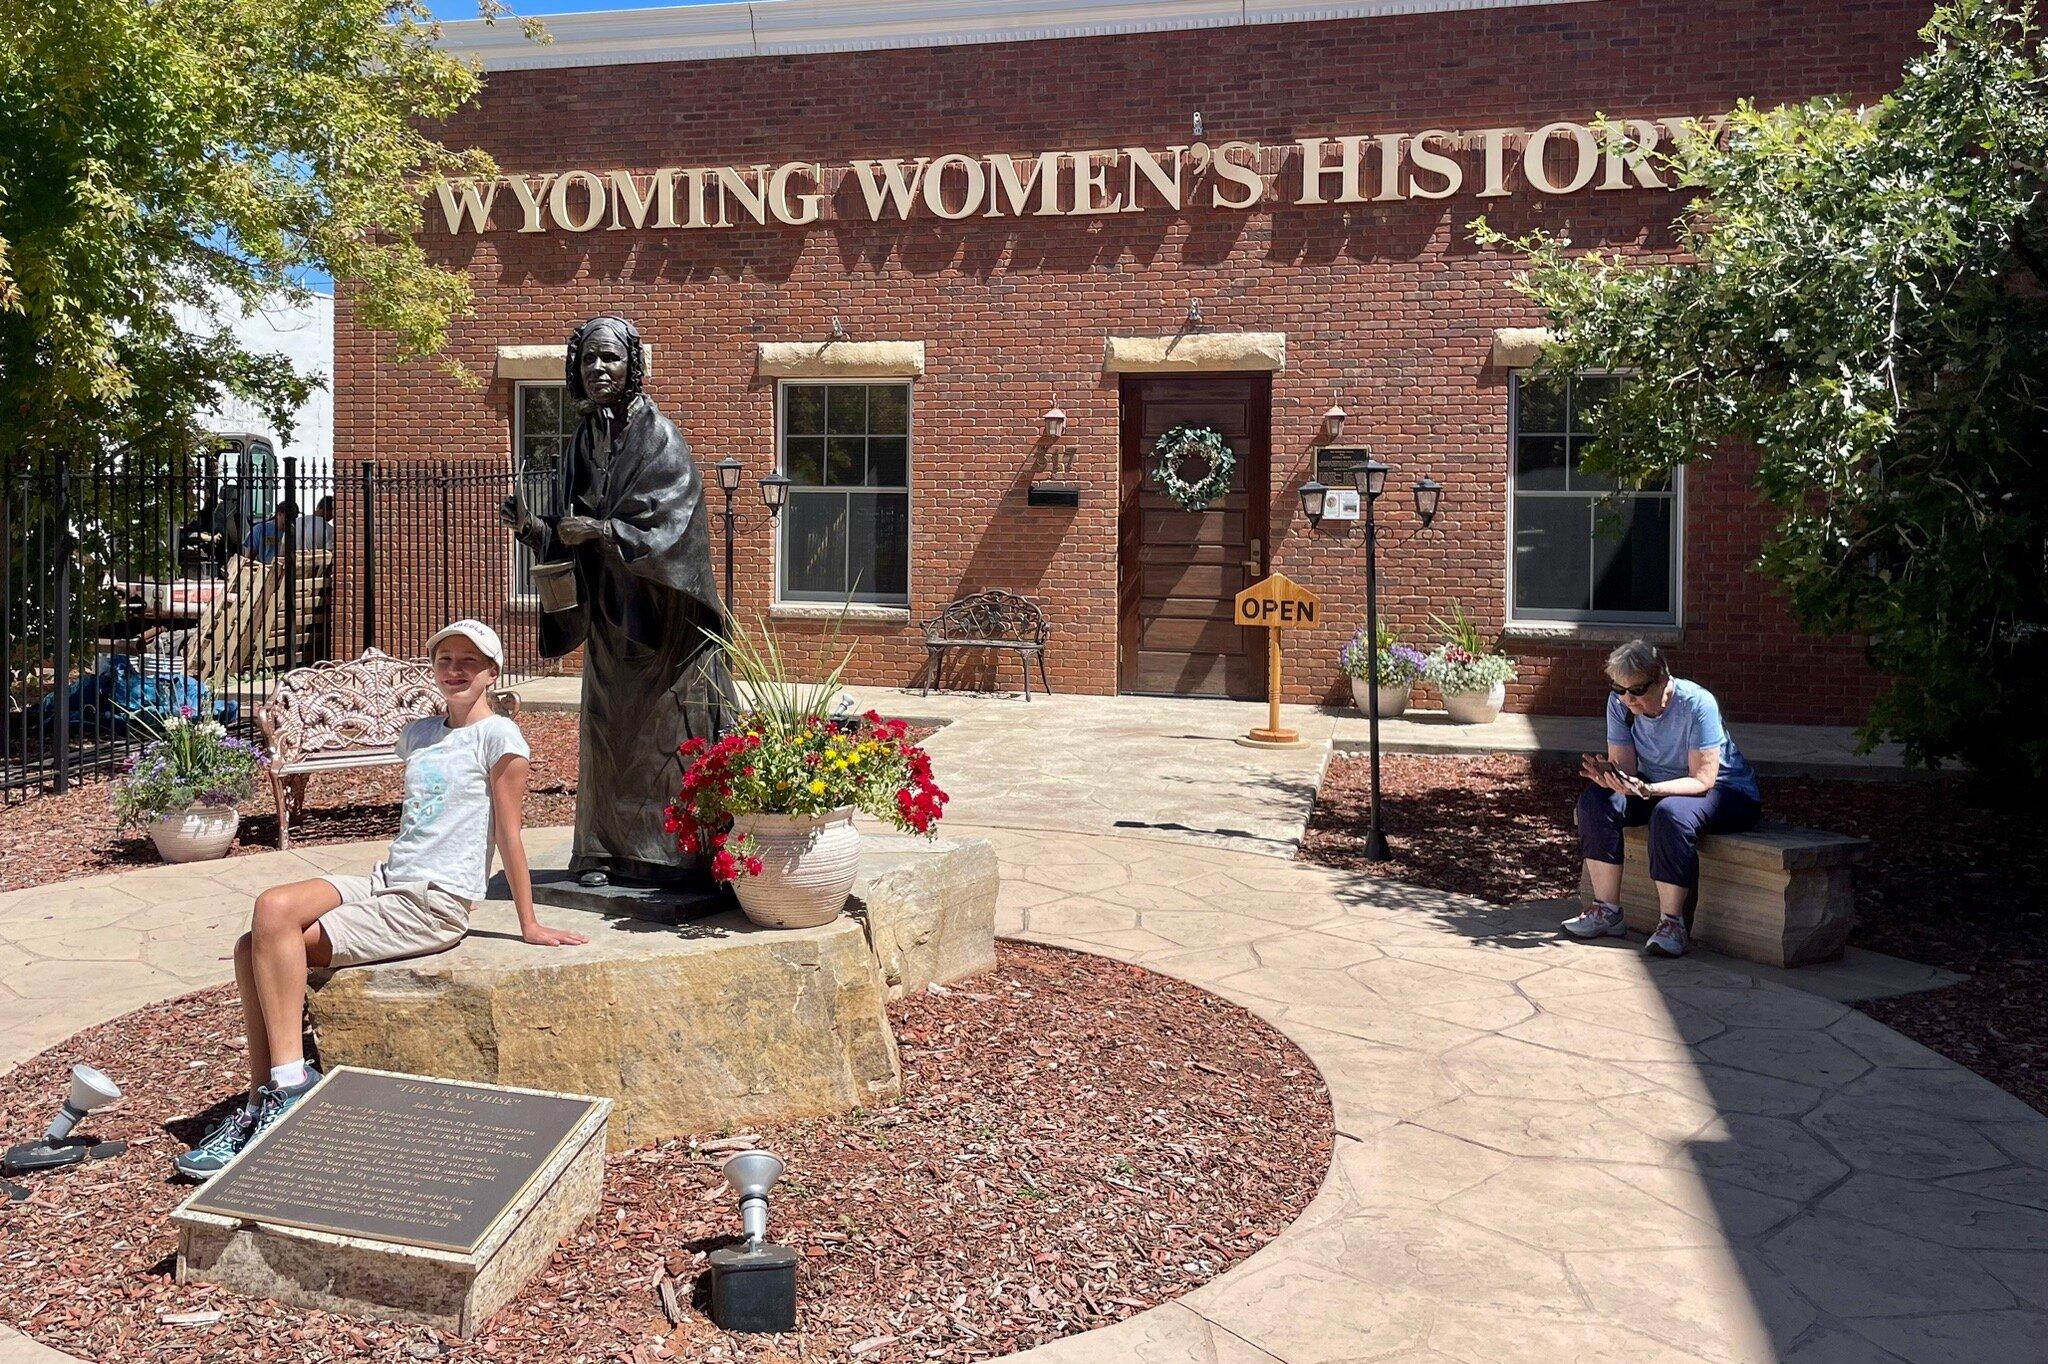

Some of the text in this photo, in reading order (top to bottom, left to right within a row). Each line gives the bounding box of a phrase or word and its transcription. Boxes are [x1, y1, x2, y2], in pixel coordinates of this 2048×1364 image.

[434, 162, 825, 236] WYOMING
[849, 140, 1265, 221] WOMEN'S
[1294, 114, 1732, 204] HISTORY
[1242, 598, 1314, 622] OPEN
[394, 1084, 521, 1104] "THE FRANCHISE"
[328, 1111, 367, 1119] bestowal
[295, 1121, 328, 1129] became
[403, 1136, 444, 1147] territory
[505, 1150, 531, 1158] right.
[340, 1121, 379, 1130] equality
[462, 1136, 506, 1147] Wyoming
[482, 1125, 536, 1135] recognition
[277, 1138, 314, 1146] suffrage
[316, 1144, 362, 1152] movement
[340, 1138, 400, 1150] inspirational
[451, 1155, 488, 1163] women's
[255, 1158, 293, 1166] ratified
[270, 1143, 322, 1154] throughout
[390, 1161, 440, 1172] nineteenth
[290, 1154, 323, 1162] United
[323, 1159, 352, 1167] States
[352, 1163, 411, 1176] Constitution
[213, 1195, 249, 1204] historic
[237, 1174, 270, 1182] woman
[378, 1195, 409, 1203] ballot
[426, 1202, 454, 1210] block
[297, 1174, 329, 1183] Louisa
[330, 1179, 359, 1187] Swain
[360, 1184, 397, 1193] became
[415, 1193, 449, 1201] world's
[449, 1197, 474, 1205] first
[244, 1192, 290, 1201] memorial
[288, 1199, 360, 1213] commemorates
[377, 1213, 427, 1224] celebrates
[427, 1219, 450, 1227] that
[321, 1196, 364, 1206] morning
[375, 1202, 427, 1214] September
